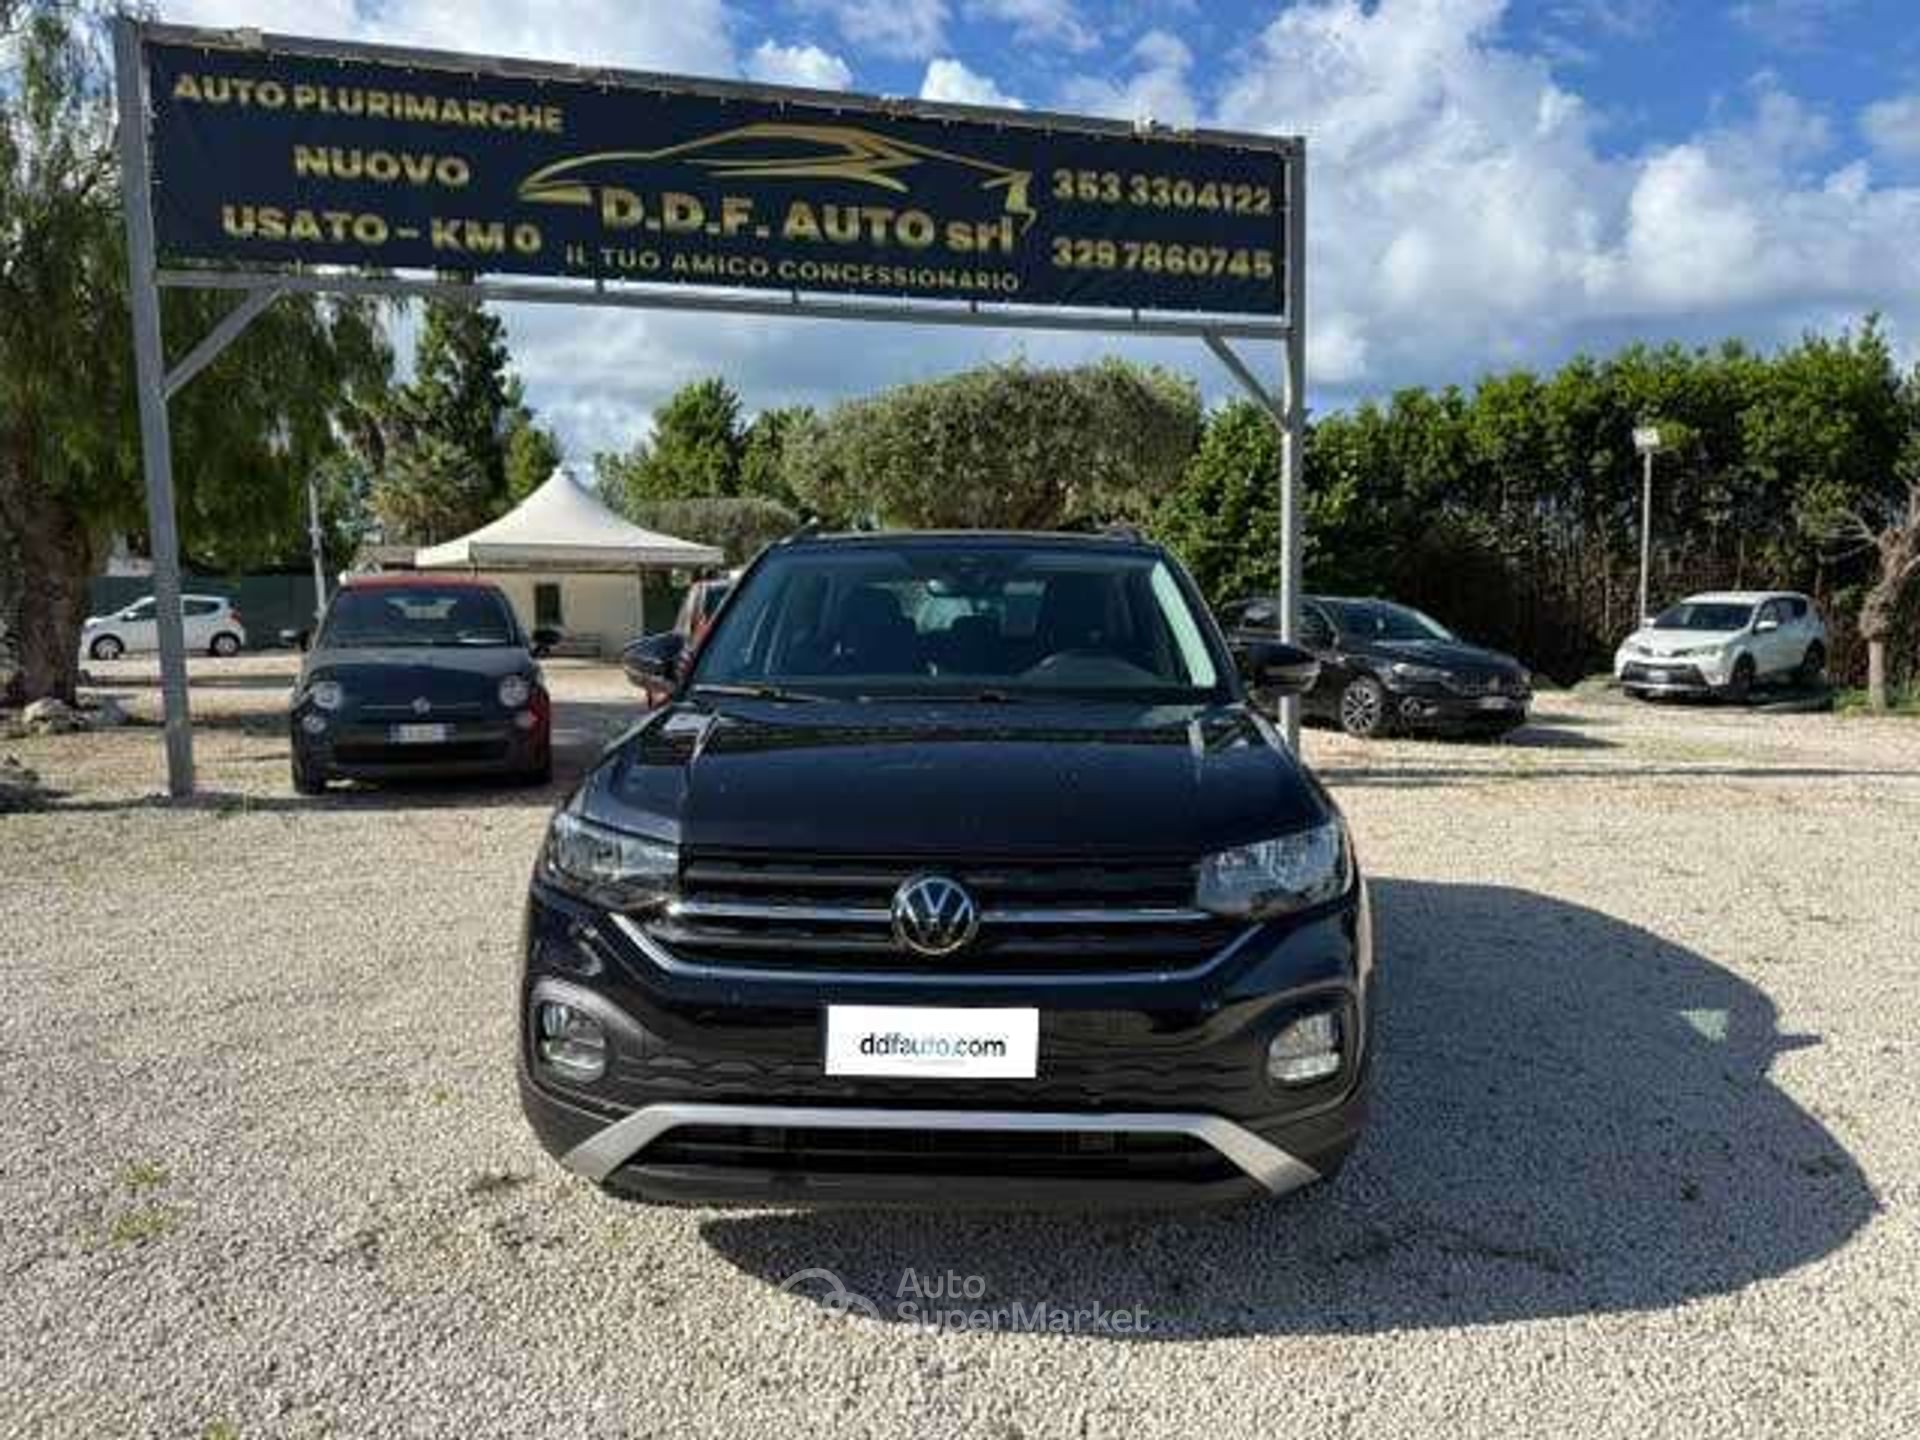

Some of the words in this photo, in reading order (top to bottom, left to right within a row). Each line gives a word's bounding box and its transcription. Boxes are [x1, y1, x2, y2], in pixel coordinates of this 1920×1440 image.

[173, 74, 287, 110] AUTO
[294, 84, 563, 133] PLURIMARCHE
[293, 144, 470, 187] NUOVO
[1053, 169, 1121, 203] 353
[1129, 174, 1273, 215] 3304122
[221, 205, 388, 245] USATO
[601, 186, 770, 239] D.D.F.
[783, 200, 936, 249] AUTO
[946, 216, 1013, 252] srl
[565, 243, 587, 267] IL
[601, 247, 661, 271] TUO
[671, 251, 769, 280] AMICO
[777, 259, 1020, 293] CONCESSIONARIO
[1122, 241, 1274, 279] 7860745
[859, 1032, 1007, 1058] ddfauto.com
